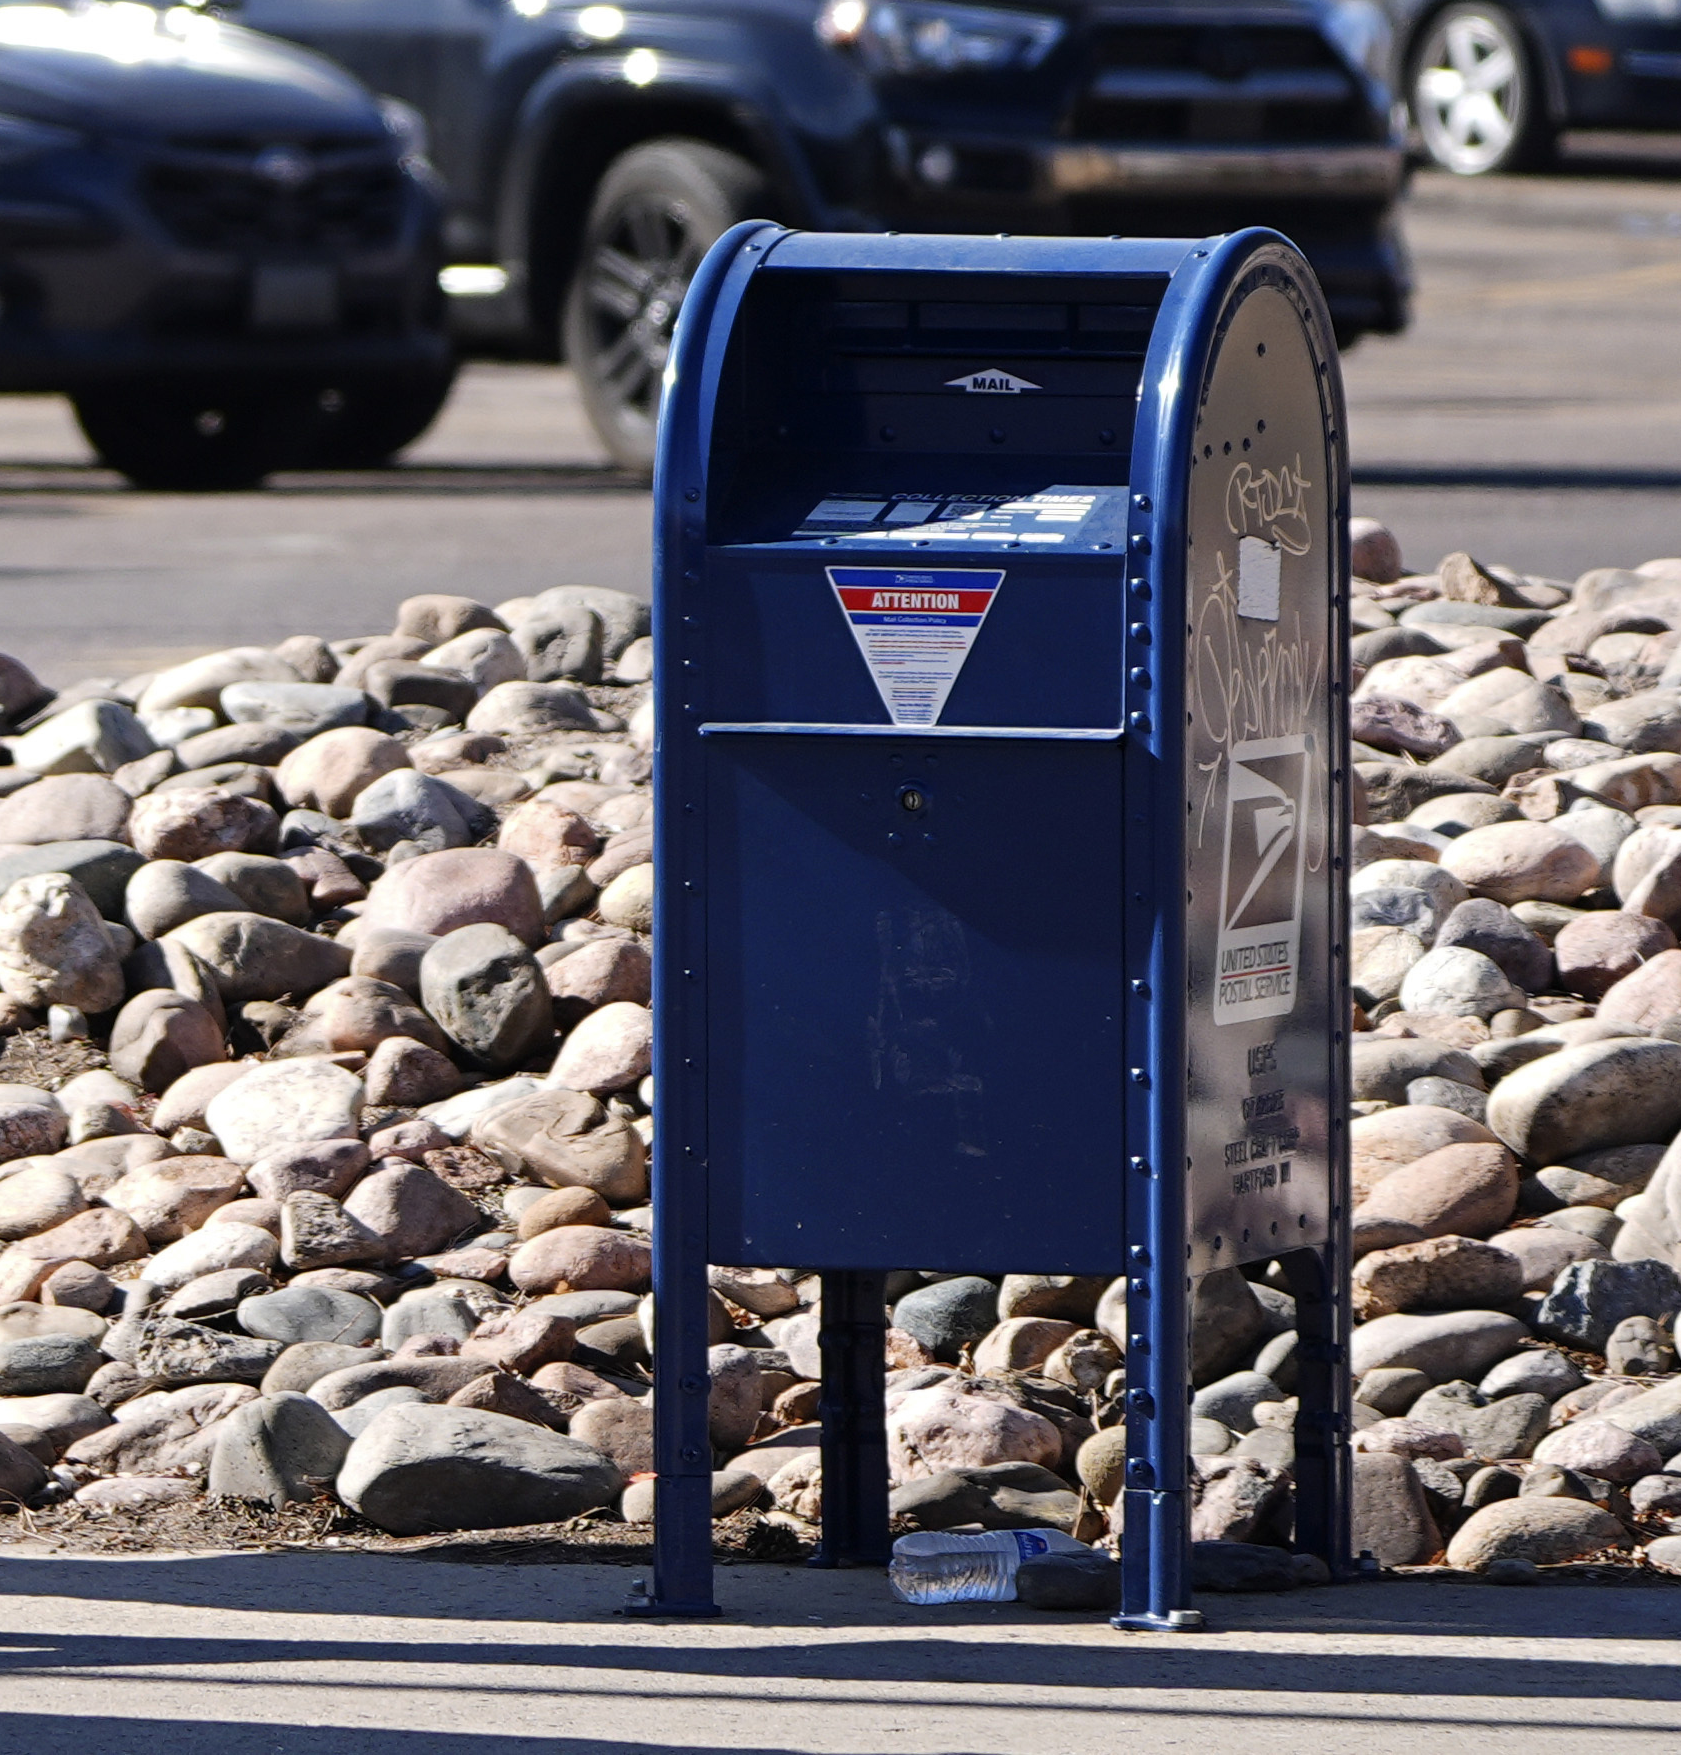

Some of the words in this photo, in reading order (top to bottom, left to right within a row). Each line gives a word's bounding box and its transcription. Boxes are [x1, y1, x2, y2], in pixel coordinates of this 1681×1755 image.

[972, 377, 1015, 391] MAIL
[891, 493, 1028, 503] COLLECTION
[1031, 495, 1097, 504] TIMES
[871, 591, 960, 610] ATTENTION
[1221, 945, 1255, 973] UNITED
[1256, 941, 1290, 968] STATES
[1219, 980, 1254, 1006] POSTAL
[1253, 972, 1292, 1001] SERVICE
